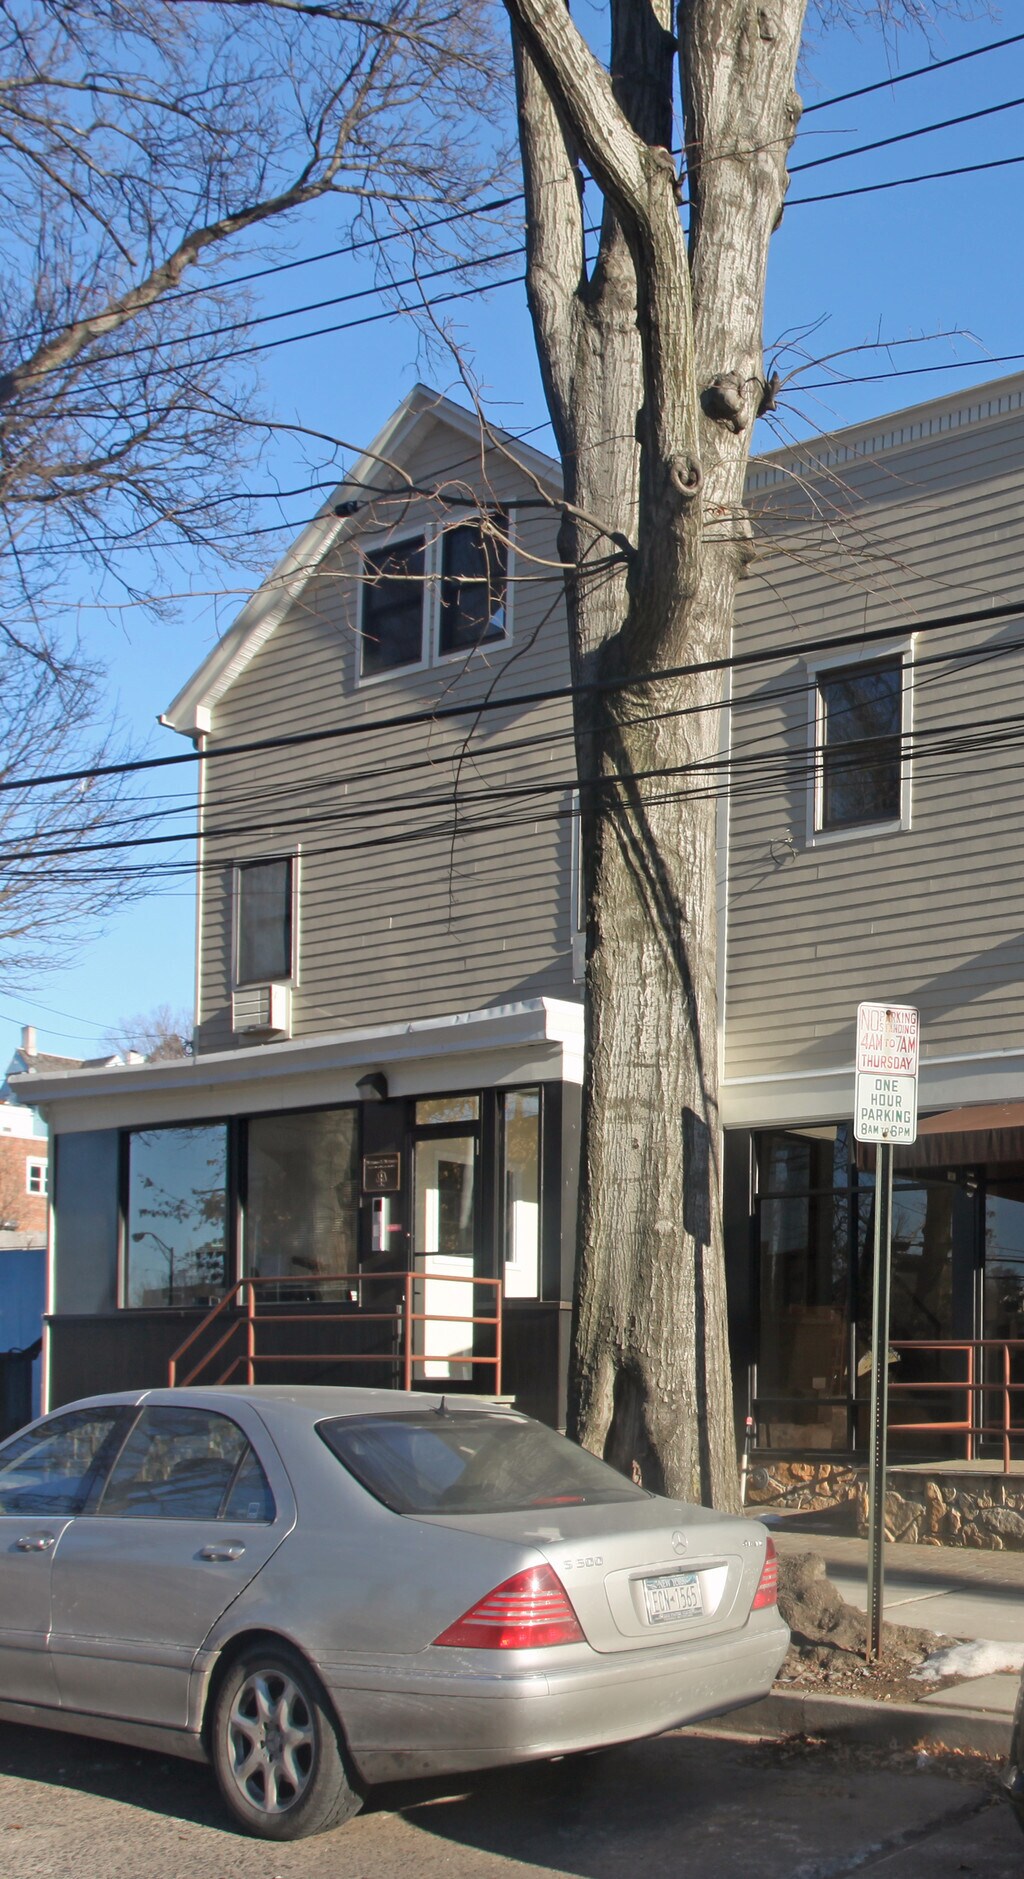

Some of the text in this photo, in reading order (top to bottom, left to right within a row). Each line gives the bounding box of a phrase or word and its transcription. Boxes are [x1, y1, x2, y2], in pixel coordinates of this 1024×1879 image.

[861, 1009, 880, 1031] NO
[860, 1033, 883, 1051] 4AM
[896, 1035, 916, 1053] 7AM
[861, 1054, 913, 1070] THURSDAY
[875, 1079, 899, 1092] ONE
[871, 1093, 902, 1107] HOUR
[861, 1108, 911, 1123] PARKING
[861, 1122, 879, 1135] 8AM
[890, 1125, 910, 1137] 6PM
